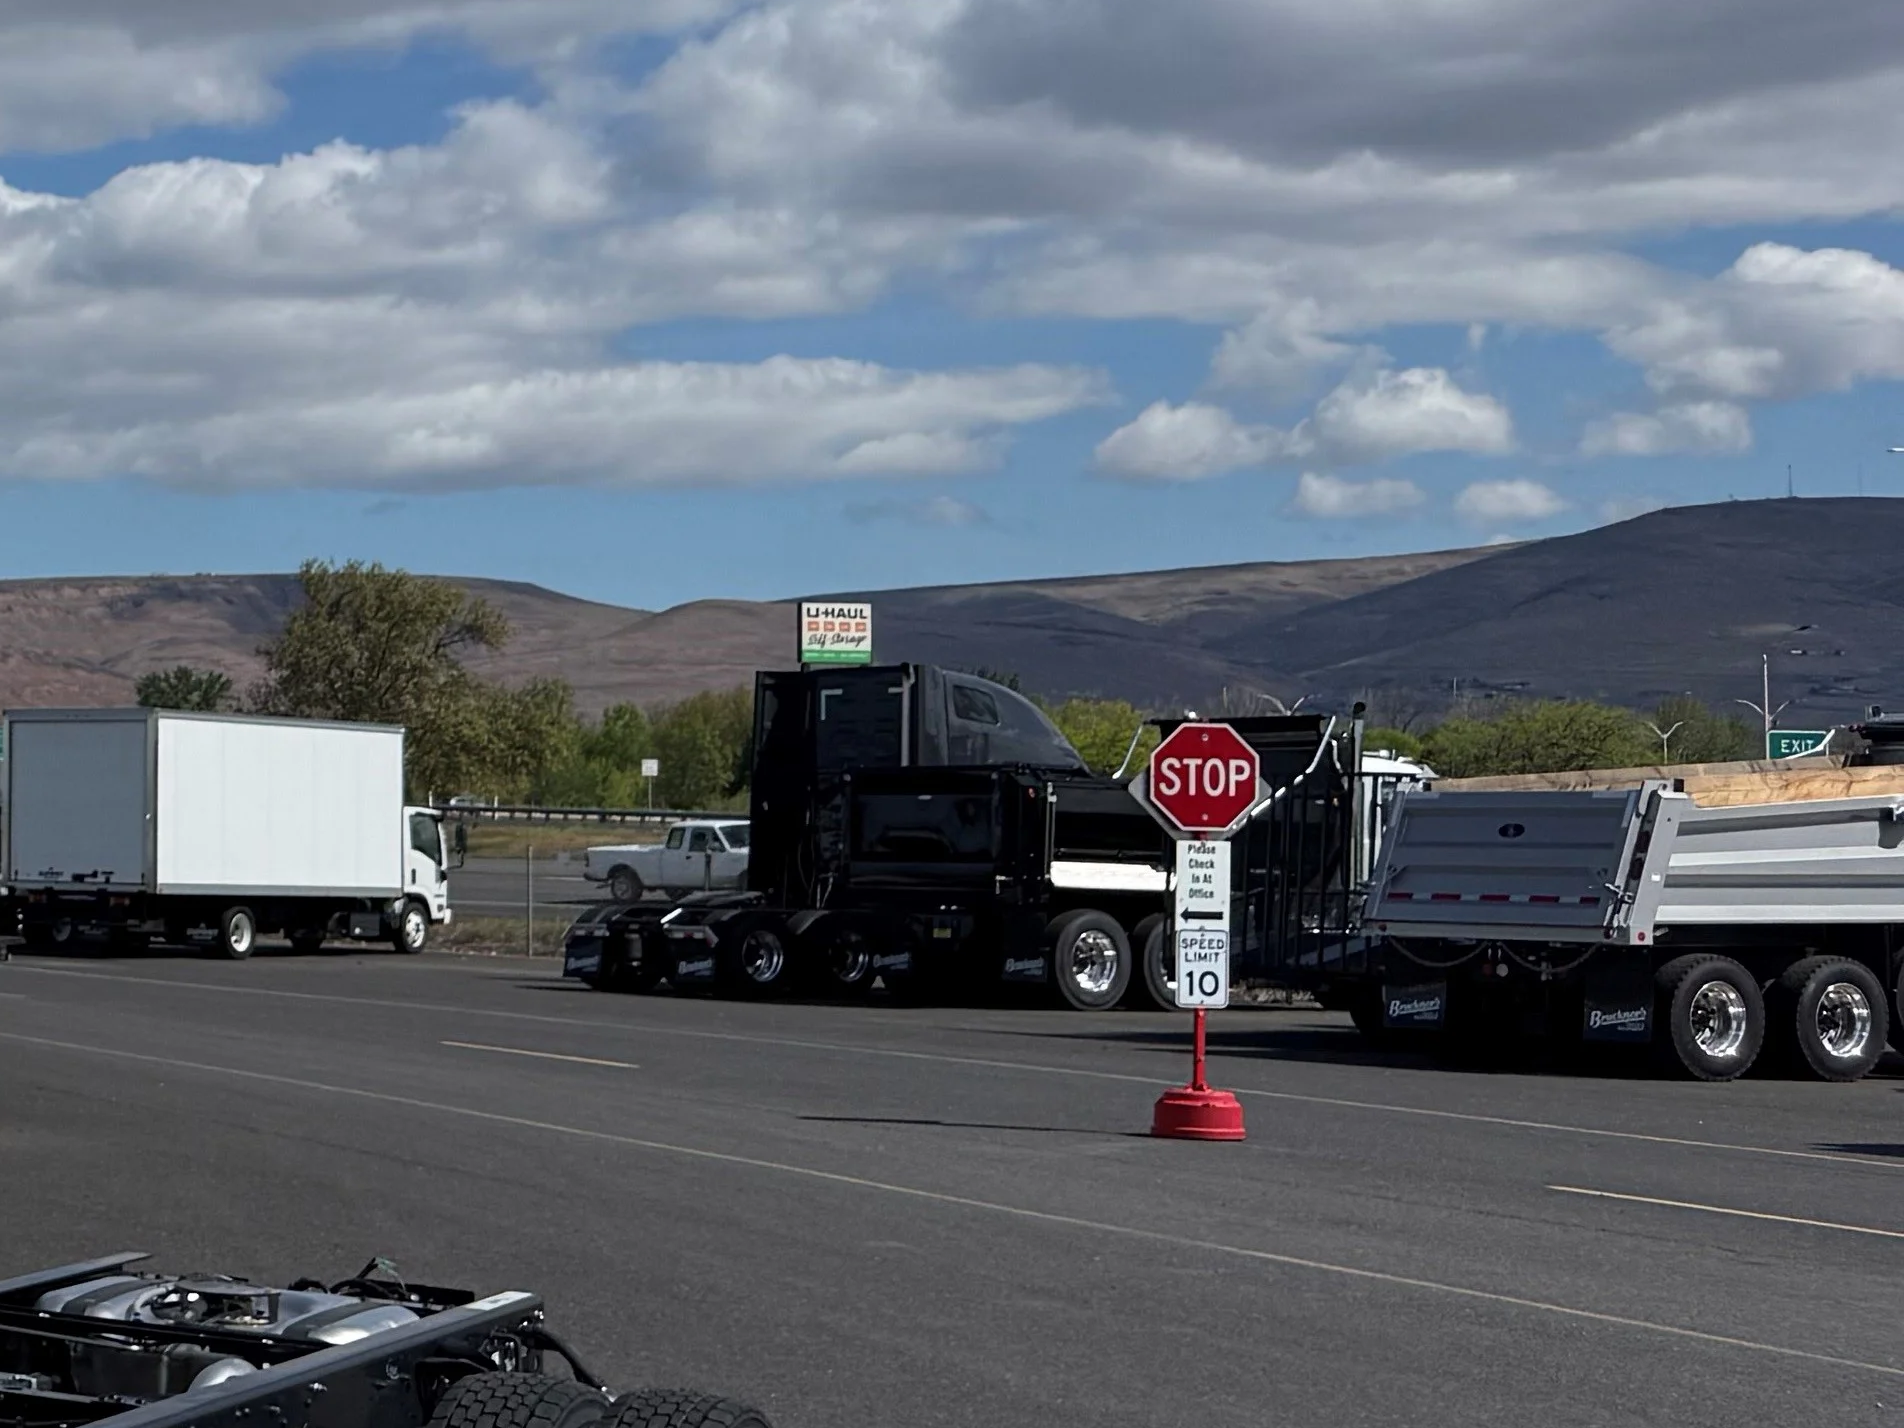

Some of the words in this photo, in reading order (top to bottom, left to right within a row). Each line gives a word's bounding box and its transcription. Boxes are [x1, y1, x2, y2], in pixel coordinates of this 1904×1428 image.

[806, 607, 867, 619] U-HAUL
[1781, 739, 1814, 752] EXIT
[1158, 757, 1251, 797] STOP
[1187, 844, 1216, 855] Please
[1188, 858, 1215, 869] Check
[1202, 873, 1212, 884] At
[1188, 887, 1214, 899] Office
[1181, 938, 1225, 950] SPEED
[1184, 952, 1219, 963] LIMIT
[1186, 970, 1219, 997] 10
